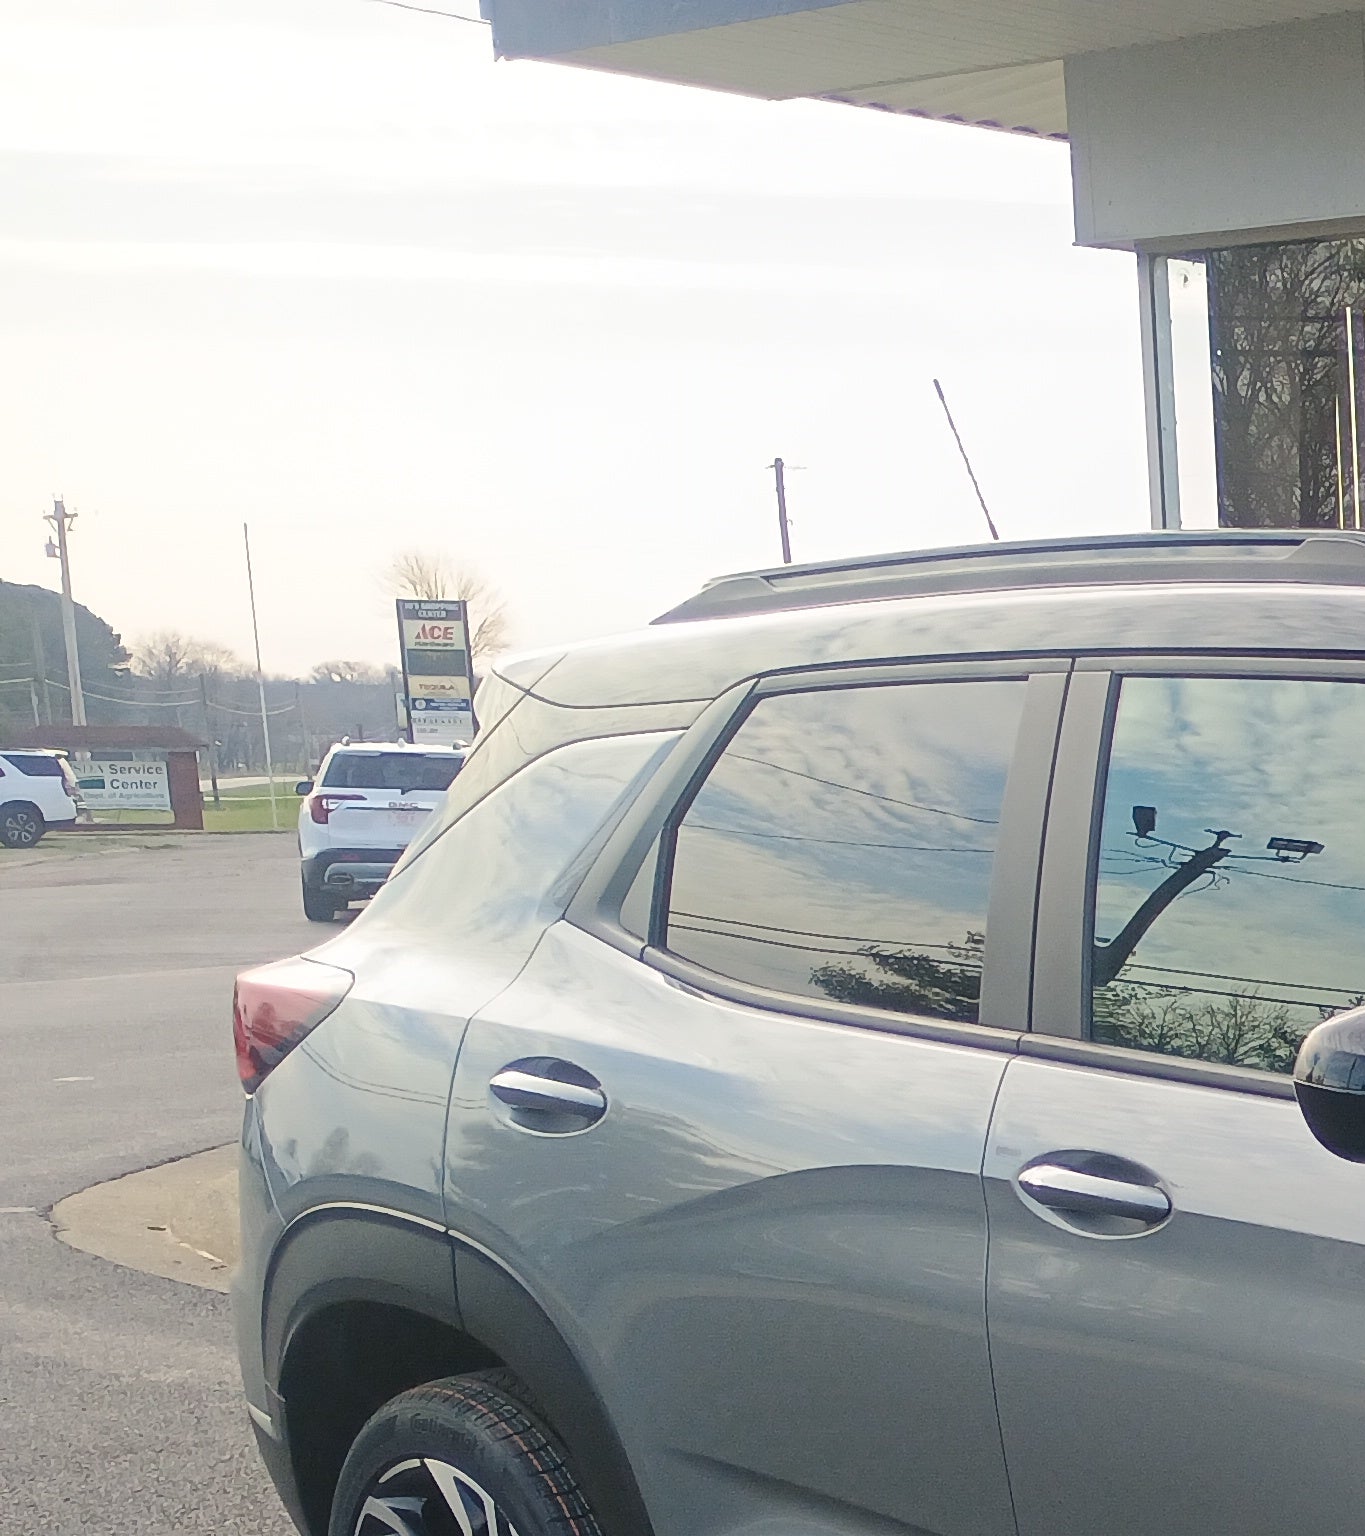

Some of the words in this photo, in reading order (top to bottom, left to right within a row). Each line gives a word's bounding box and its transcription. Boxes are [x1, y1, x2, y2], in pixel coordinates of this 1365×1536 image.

[415, 623, 455, 641] ACE
[109, 763, 163, 775] Service
[110, 778, 158, 790] Center
[388, 801, 418, 809] GMC
